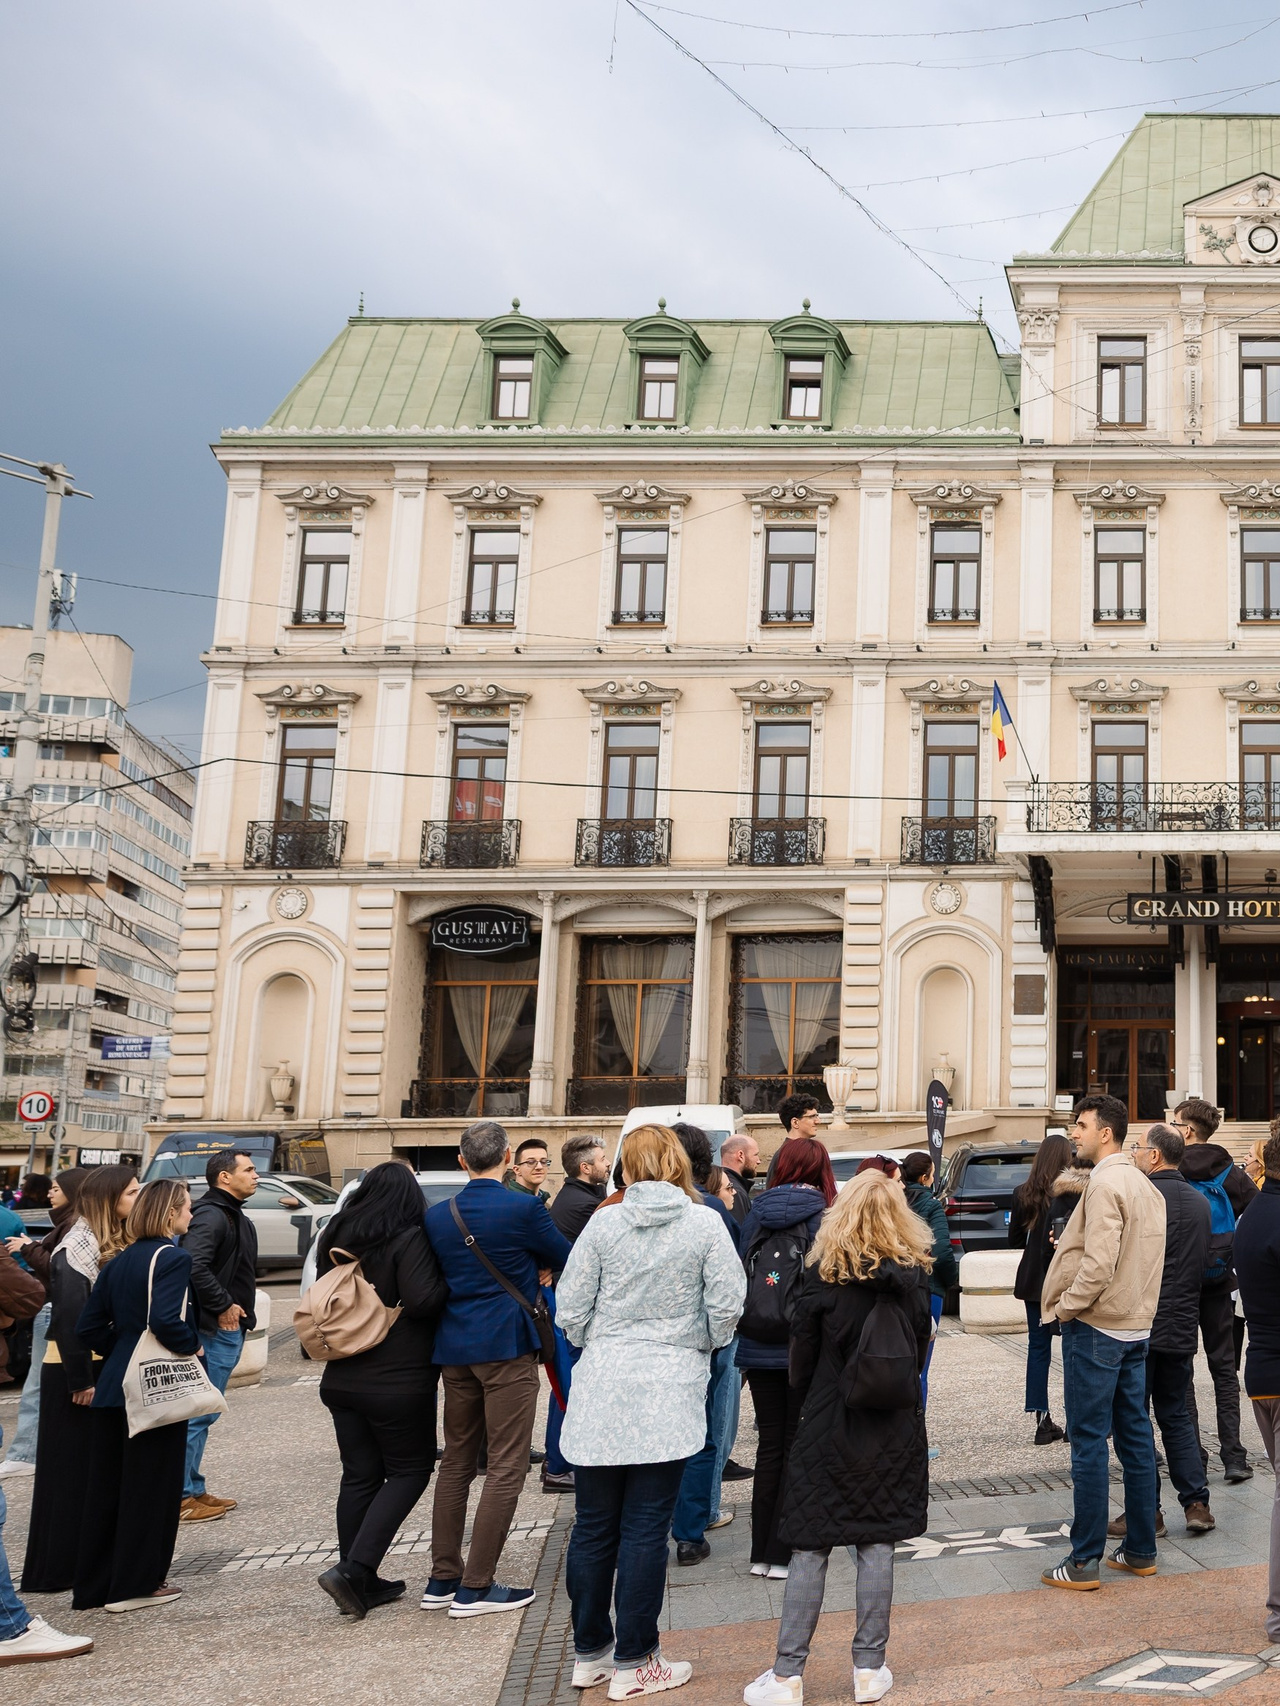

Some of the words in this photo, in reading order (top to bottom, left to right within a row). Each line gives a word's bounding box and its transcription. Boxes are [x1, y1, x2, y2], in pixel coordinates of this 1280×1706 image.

[1133, 900, 1220, 918] GRAND
[1065, 954, 1165, 964] RESTAURANT
[25, 1098, 47, 1114] 10
[144, 1364, 172, 1378] FROM
[145, 1377, 158, 1389] TO
[160, 1370, 202, 1386] INFLUENCE
